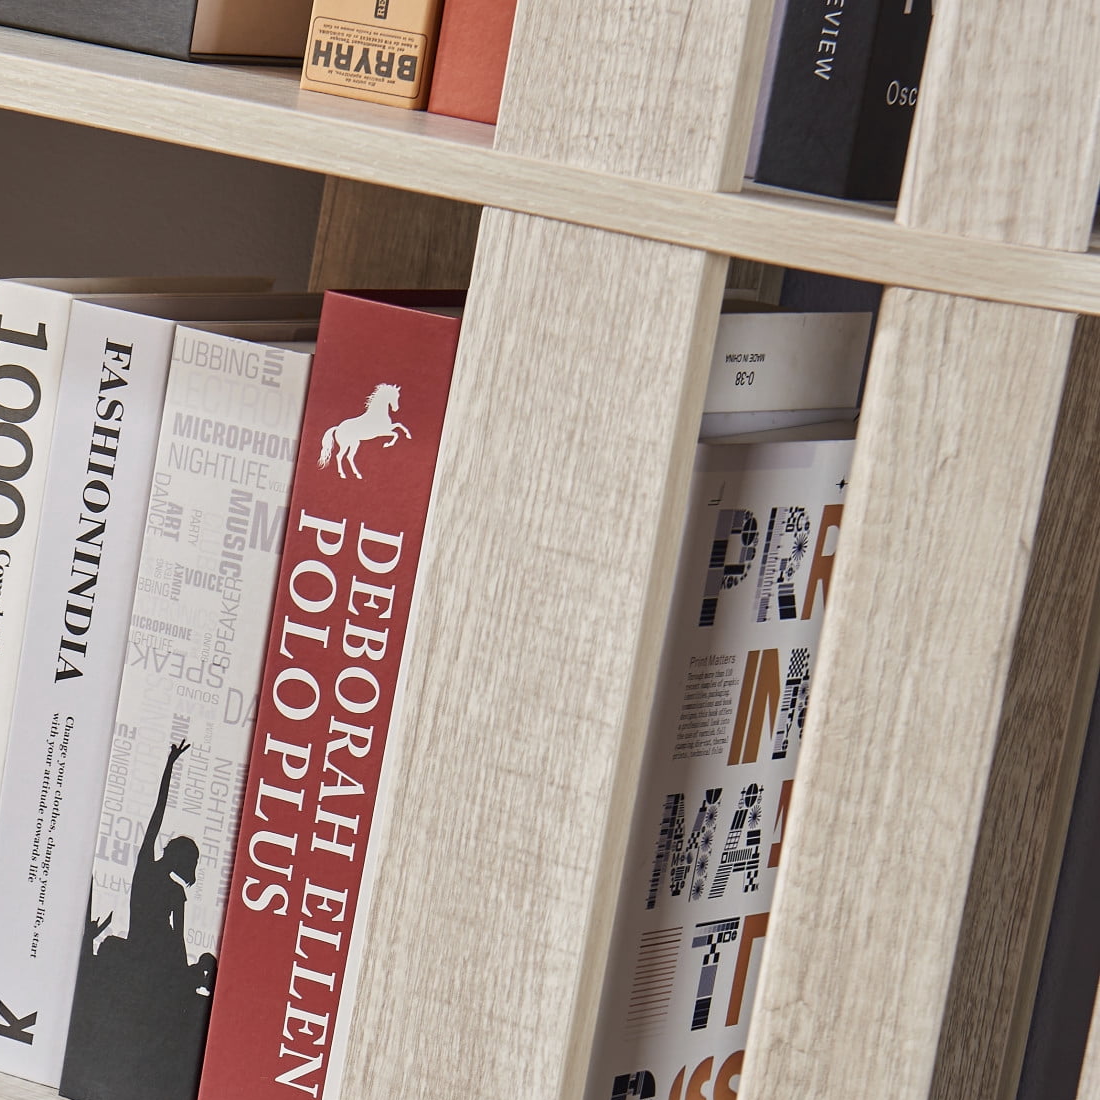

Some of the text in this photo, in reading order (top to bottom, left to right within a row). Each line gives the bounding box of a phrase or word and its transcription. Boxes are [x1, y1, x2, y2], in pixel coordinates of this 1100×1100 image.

[311, 39, 418, 82] BRYRH
[725, 354, 766, 363] MADE IN CHINA
[735, 371, 755, 386] 0-38
[168, 442, 270, 491] NIGHTLIFE
[54, 337, 134, 684] FASHIONINDIA
[147, 471, 172, 538] DANCE
[162, 501, 184, 543] ART
[218, 488, 253, 579] MUSIC
[170, 562, 185, 602] FUNKY
[184, 567, 225, 593] VOICE
[211, 574, 243, 674] SPEAKER
[128, 640, 225, 690] SPEAK
[176, 684, 220, 705] SOUND
[241, 509, 347, 916] POLO PLUS
[27, 712, 60, 883] with your attitude towards life
[105, 738, 133, 813] CLUBBING
[181, 743, 211, 817] NIGHTLIFE
[274, 522, 404, 1099] DEBORAH ELLEN
[30, 716, 75, 959] Change your clothes, change your life, start
[201, 757, 233, 869] NIGHTLIFE
